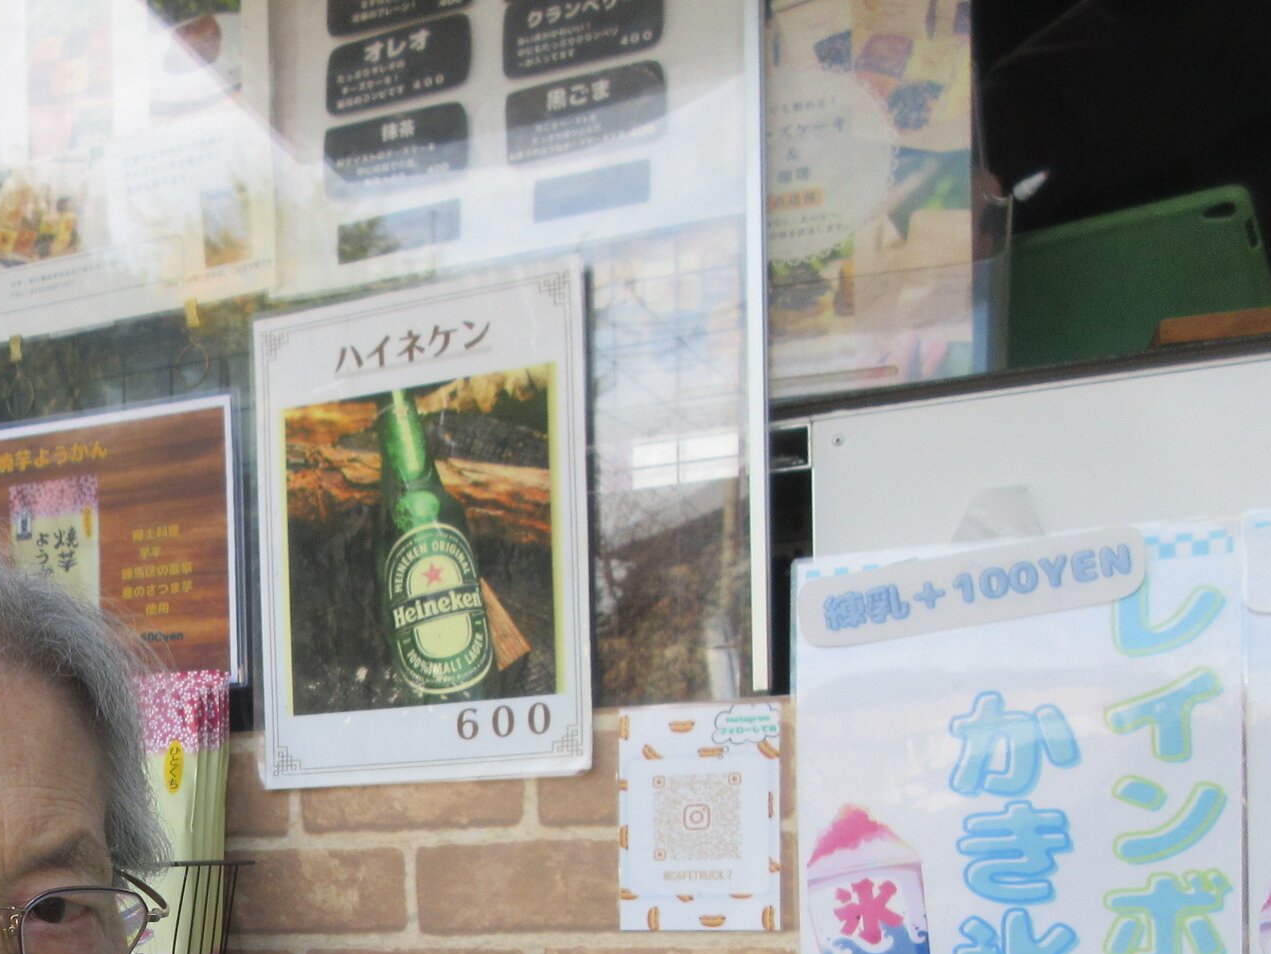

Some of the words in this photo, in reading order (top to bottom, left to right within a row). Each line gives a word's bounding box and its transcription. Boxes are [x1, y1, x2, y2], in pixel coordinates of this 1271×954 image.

[364, 28, 431, 63] オレオ
[546, 79, 611, 111] 黒ごま
[334, 320, 491, 374] ハイネケン
[431, 540, 471, 574] ORIGINAL
[392, 589, 483, 629] Heineken
[456, 702, 551, 740] 600
[835, 878, 905, 945] 氷
